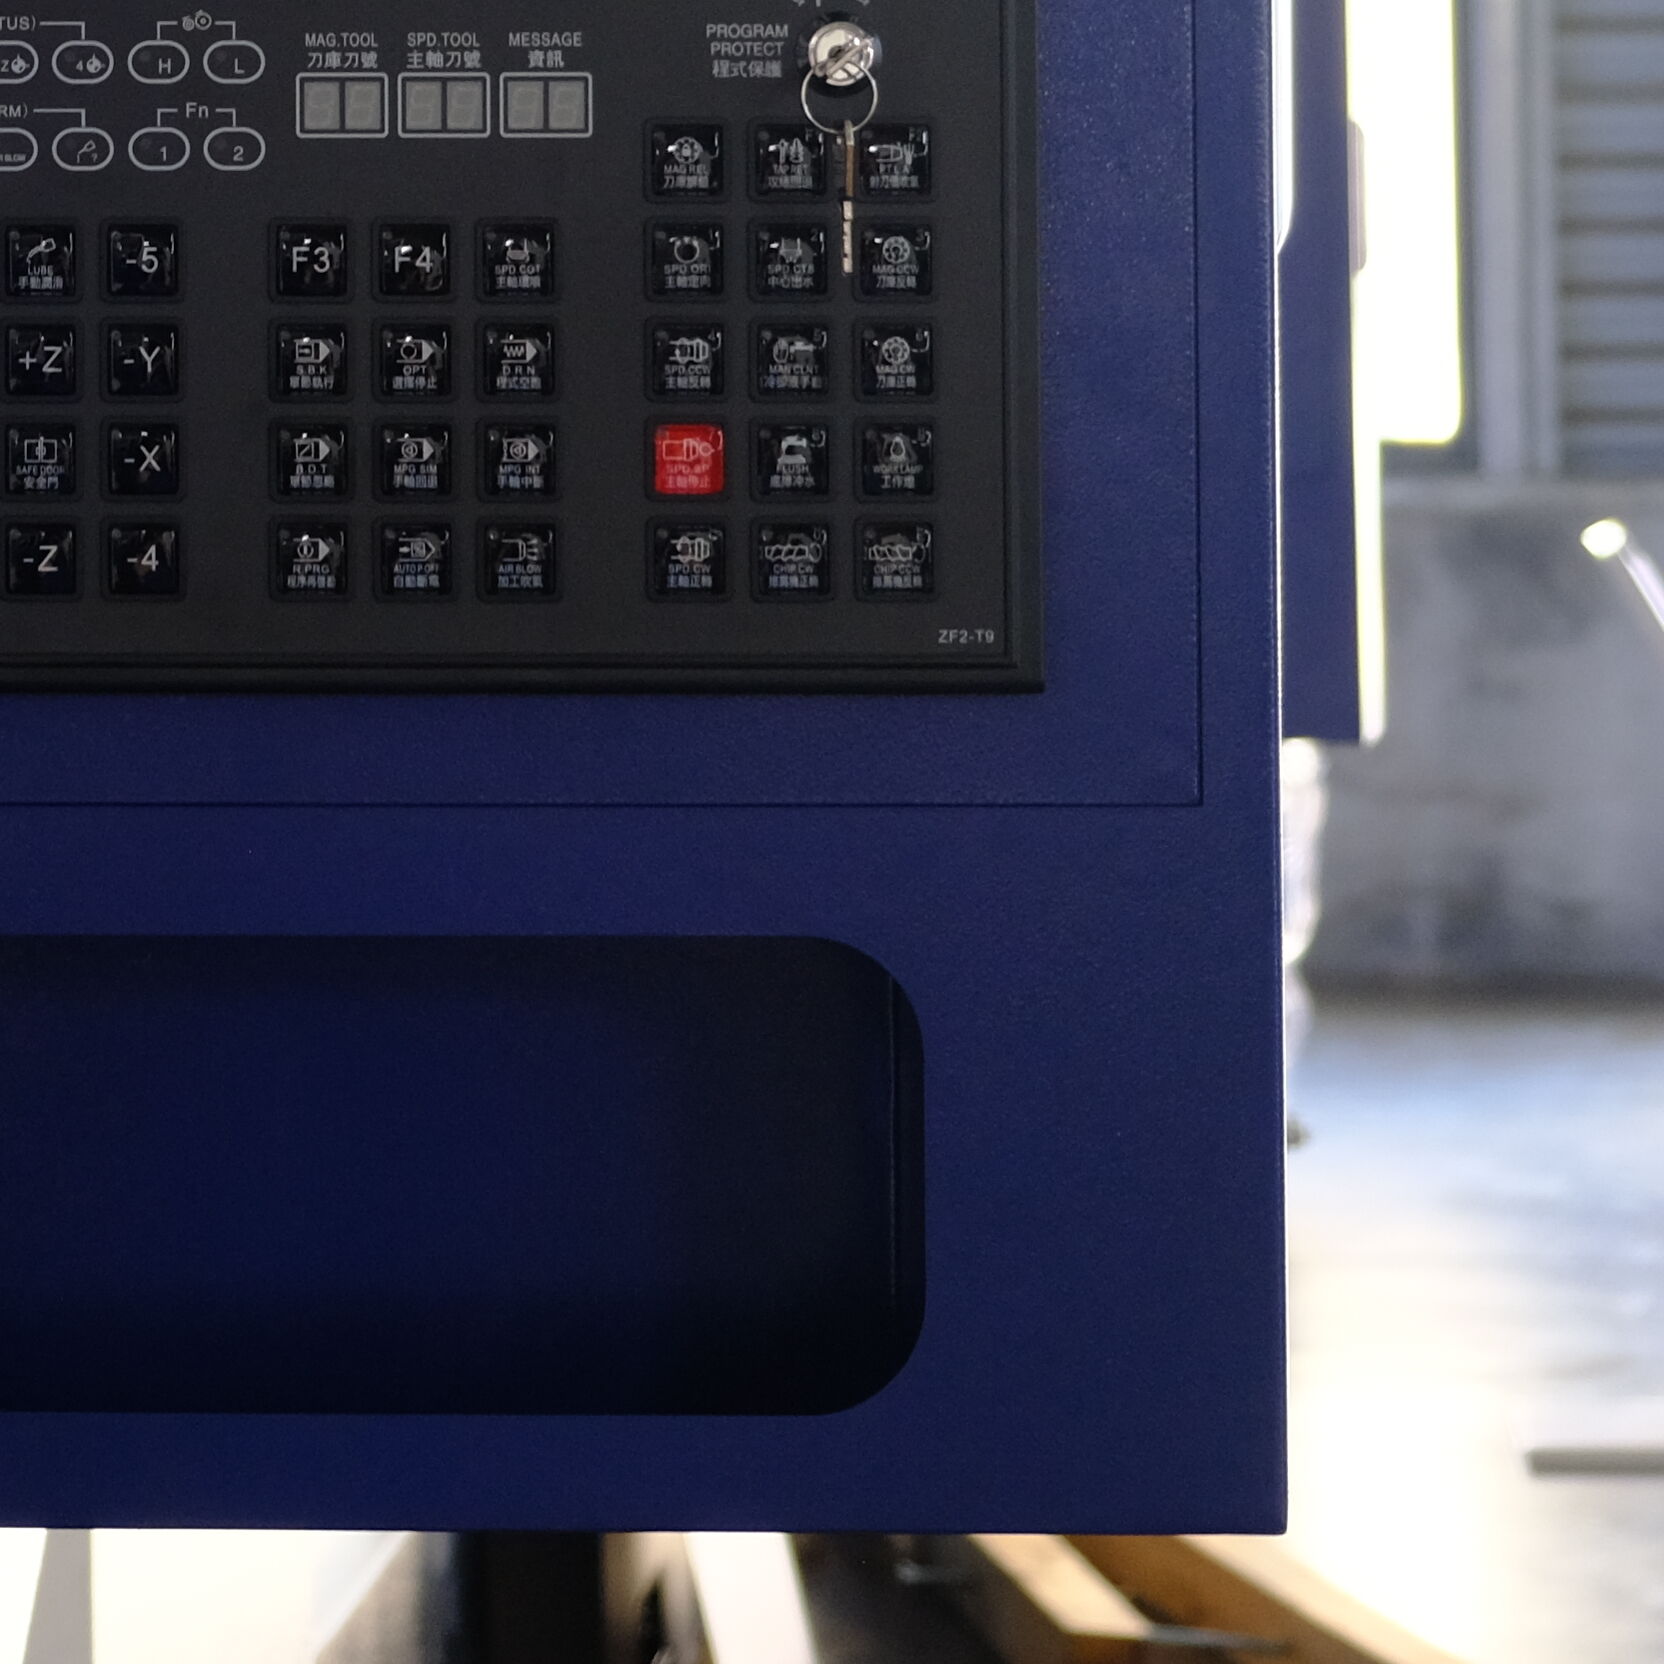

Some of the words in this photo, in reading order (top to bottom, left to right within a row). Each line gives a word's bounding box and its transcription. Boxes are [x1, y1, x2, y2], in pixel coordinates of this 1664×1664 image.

[304, 31, 379, 49] MAG.TOOL
[406, 31, 481, 48] SPD.TOOL
[507, 31, 584, 48] MESSAGE
[705, 23, 790, 40] PROGRAM
[709, 41, 785, 58] PROTECT
[185, 102, 209, 119] Fn
[233, 146, 245, 162] 2
[125, 246, 159, 275] -5
[291, 246, 331, 274] F3
[394, 245, 434, 274] F4
[18, 345, 63, 373] +Z
[122, 345, 161, 373] -Y
[402, 364, 427, 376] OPT
[123, 444, 161, 473] -X
[22, 545, 59, 573] -Z
[126, 544, 159, 573] -4
